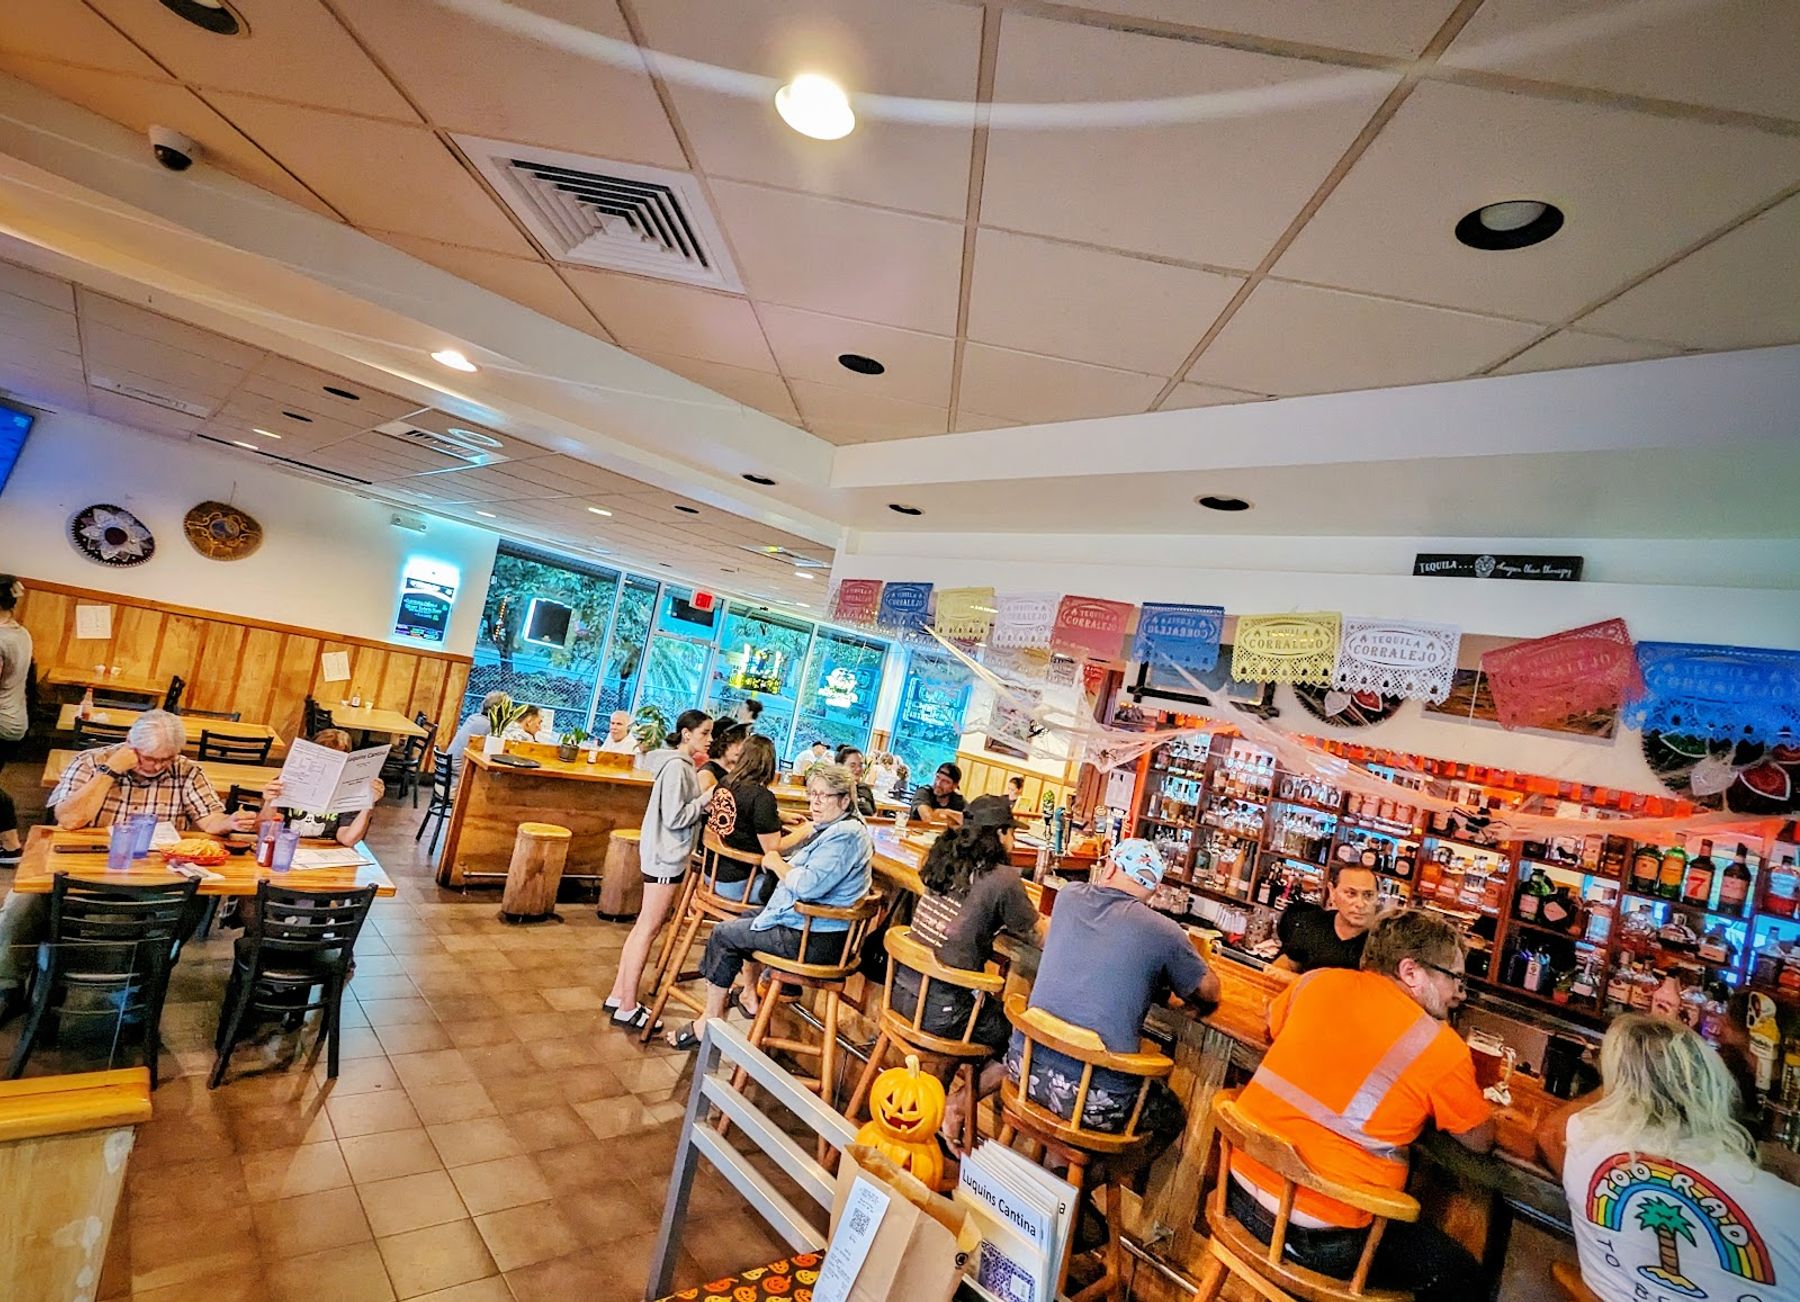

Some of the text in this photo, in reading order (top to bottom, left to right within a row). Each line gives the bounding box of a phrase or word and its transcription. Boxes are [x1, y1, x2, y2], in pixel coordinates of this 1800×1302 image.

[1066, 616, 1117, 632] CORRALEJO
[1249, 638, 1324, 650] CORRALEJO
[1372, 636, 1421, 649] TEQUILA
[1353, 644, 1438, 664] CORRALEJO
[1689, 876, 1706, 896] 7
[962, 1168, 1037, 1237] Luquins Cantina
[1595, 1161, 1750, 1248] TOO RAD
[1597, 1239, 1621, 1268] TO
